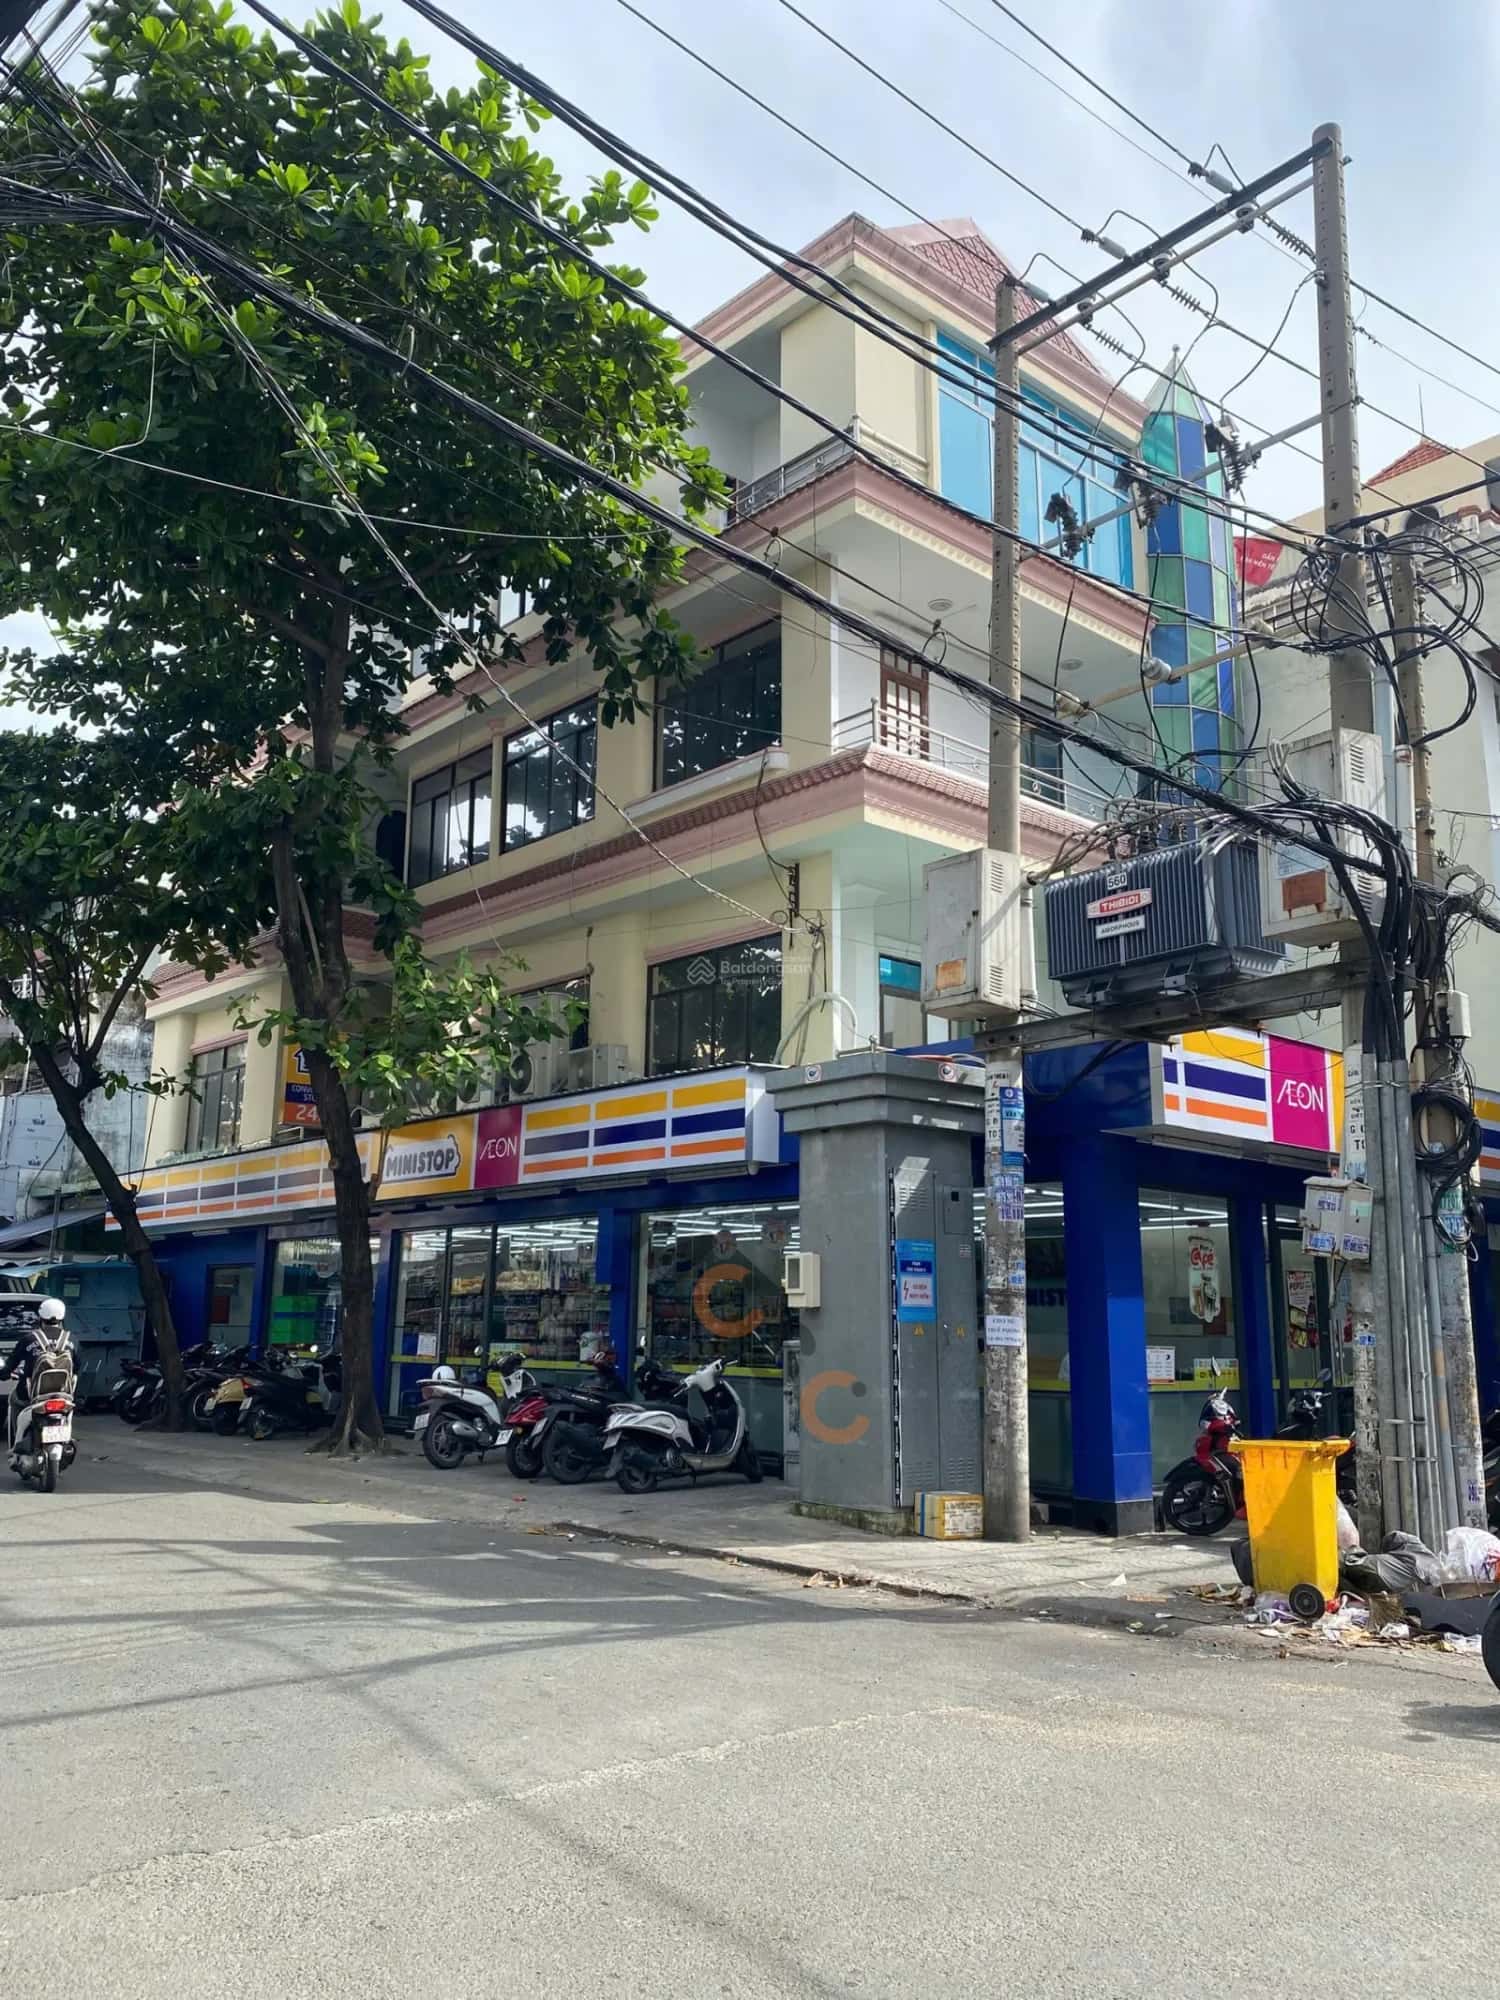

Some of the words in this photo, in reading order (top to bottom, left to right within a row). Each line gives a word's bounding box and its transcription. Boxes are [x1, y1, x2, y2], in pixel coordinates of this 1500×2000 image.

[1108, 874, 1127, 888] 560
[1102, 895, 1139, 913] THIBIDI
[386, 1148, 454, 1177] MINISTOP
